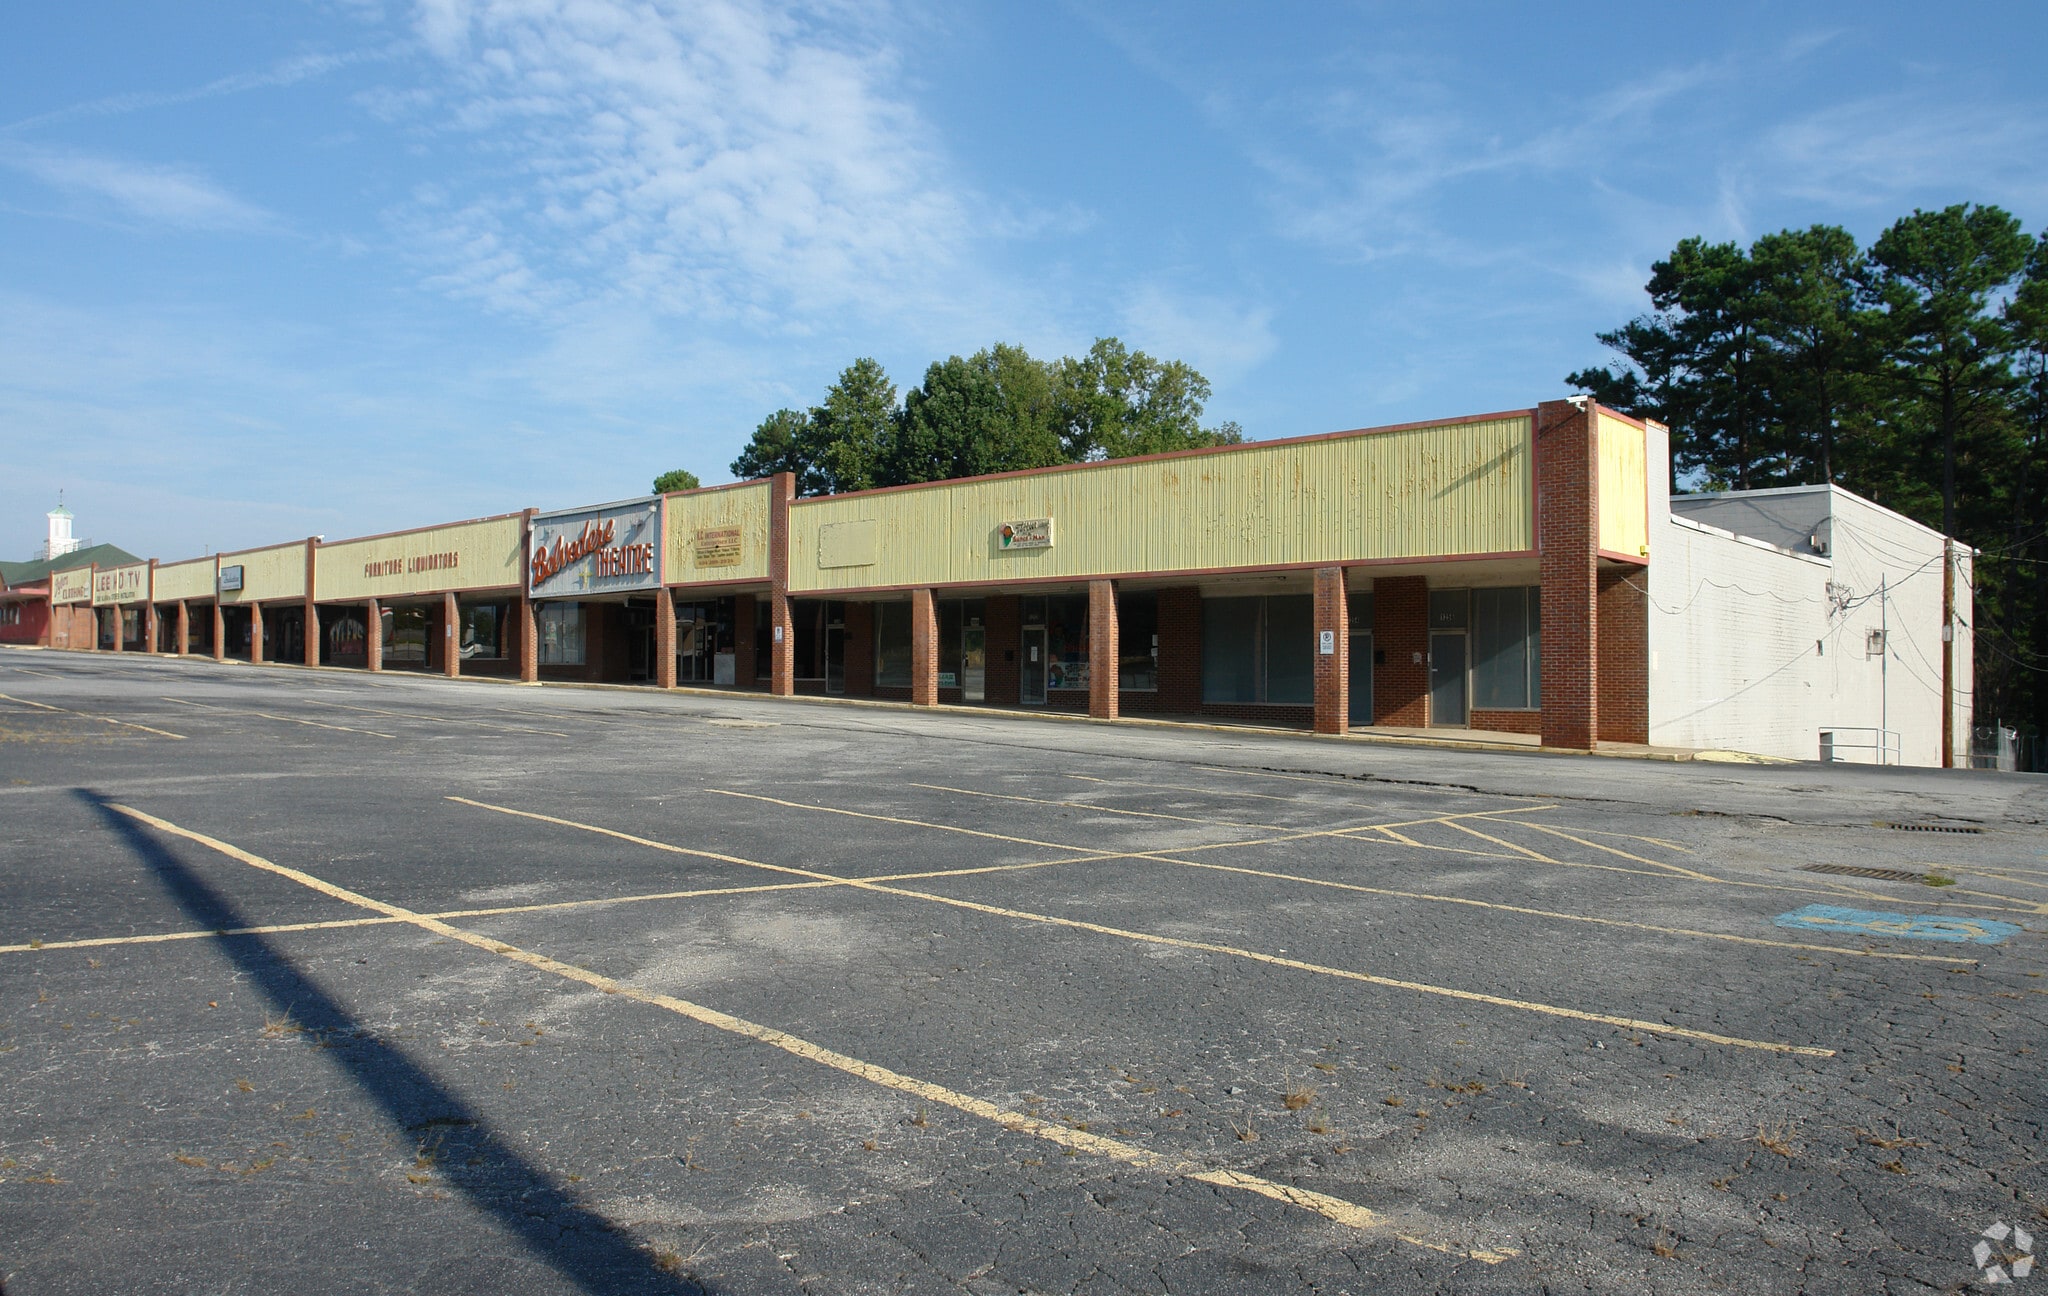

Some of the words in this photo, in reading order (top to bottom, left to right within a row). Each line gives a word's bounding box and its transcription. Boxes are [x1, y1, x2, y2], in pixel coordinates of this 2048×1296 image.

[364, 558, 402, 578] FURNITURE
[408, 552, 458, 574] LIQUIDATORS
[532, 519, 616, 586] Belvedere
[595, 542, 654, 577] THEATRE
[96, 575, 110, 592] LEE
[128, 570, 140, 588] TV
